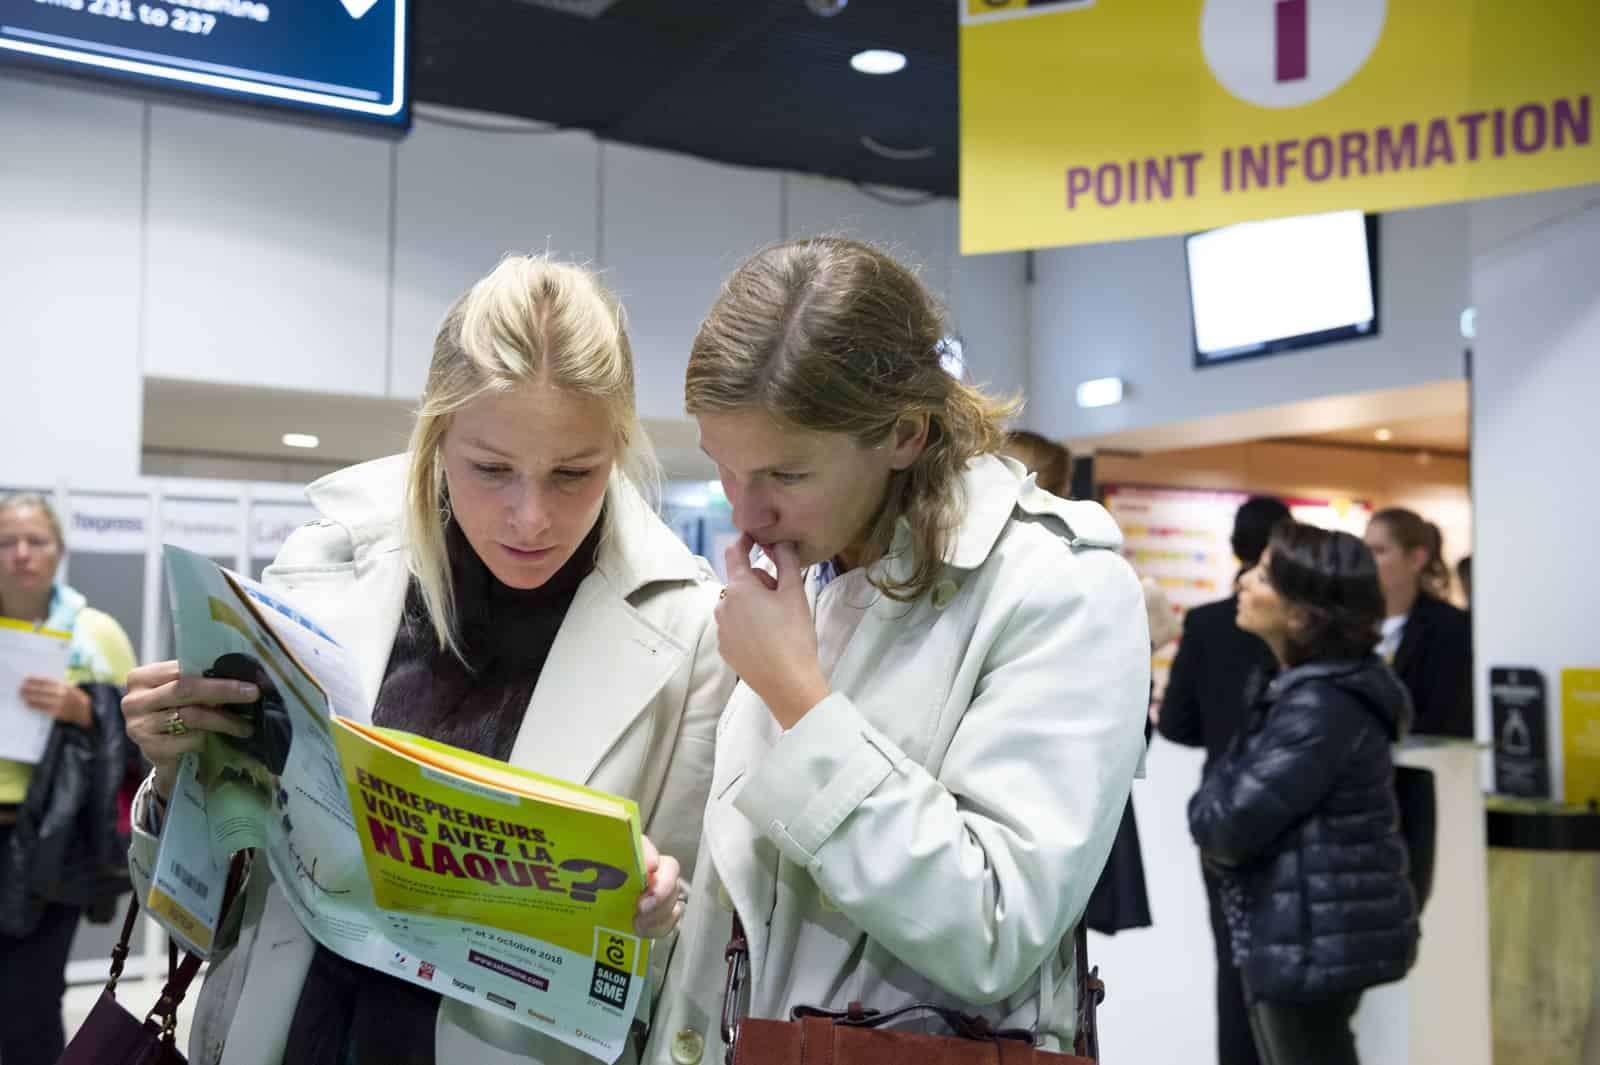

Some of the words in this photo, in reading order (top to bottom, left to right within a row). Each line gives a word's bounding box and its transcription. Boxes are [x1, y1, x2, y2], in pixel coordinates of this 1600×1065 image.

[138, 4, 169, 27] to
[170, 8, 217, 35] 237
[1066, 152, 1204, 210] POINT
[1222, 94, 1592, 193] INFORMATION
[360, 789, 428, 835] VOUS
[438, 822, 511, 857] AVEZ
[518, 842, 555, 865] LA
[496, 936, 537, 955] octobre
[538, 950, 564, 966] 2018
[593, 979, 625, 1003] SME
[597, 967, 626, 986] SALON
